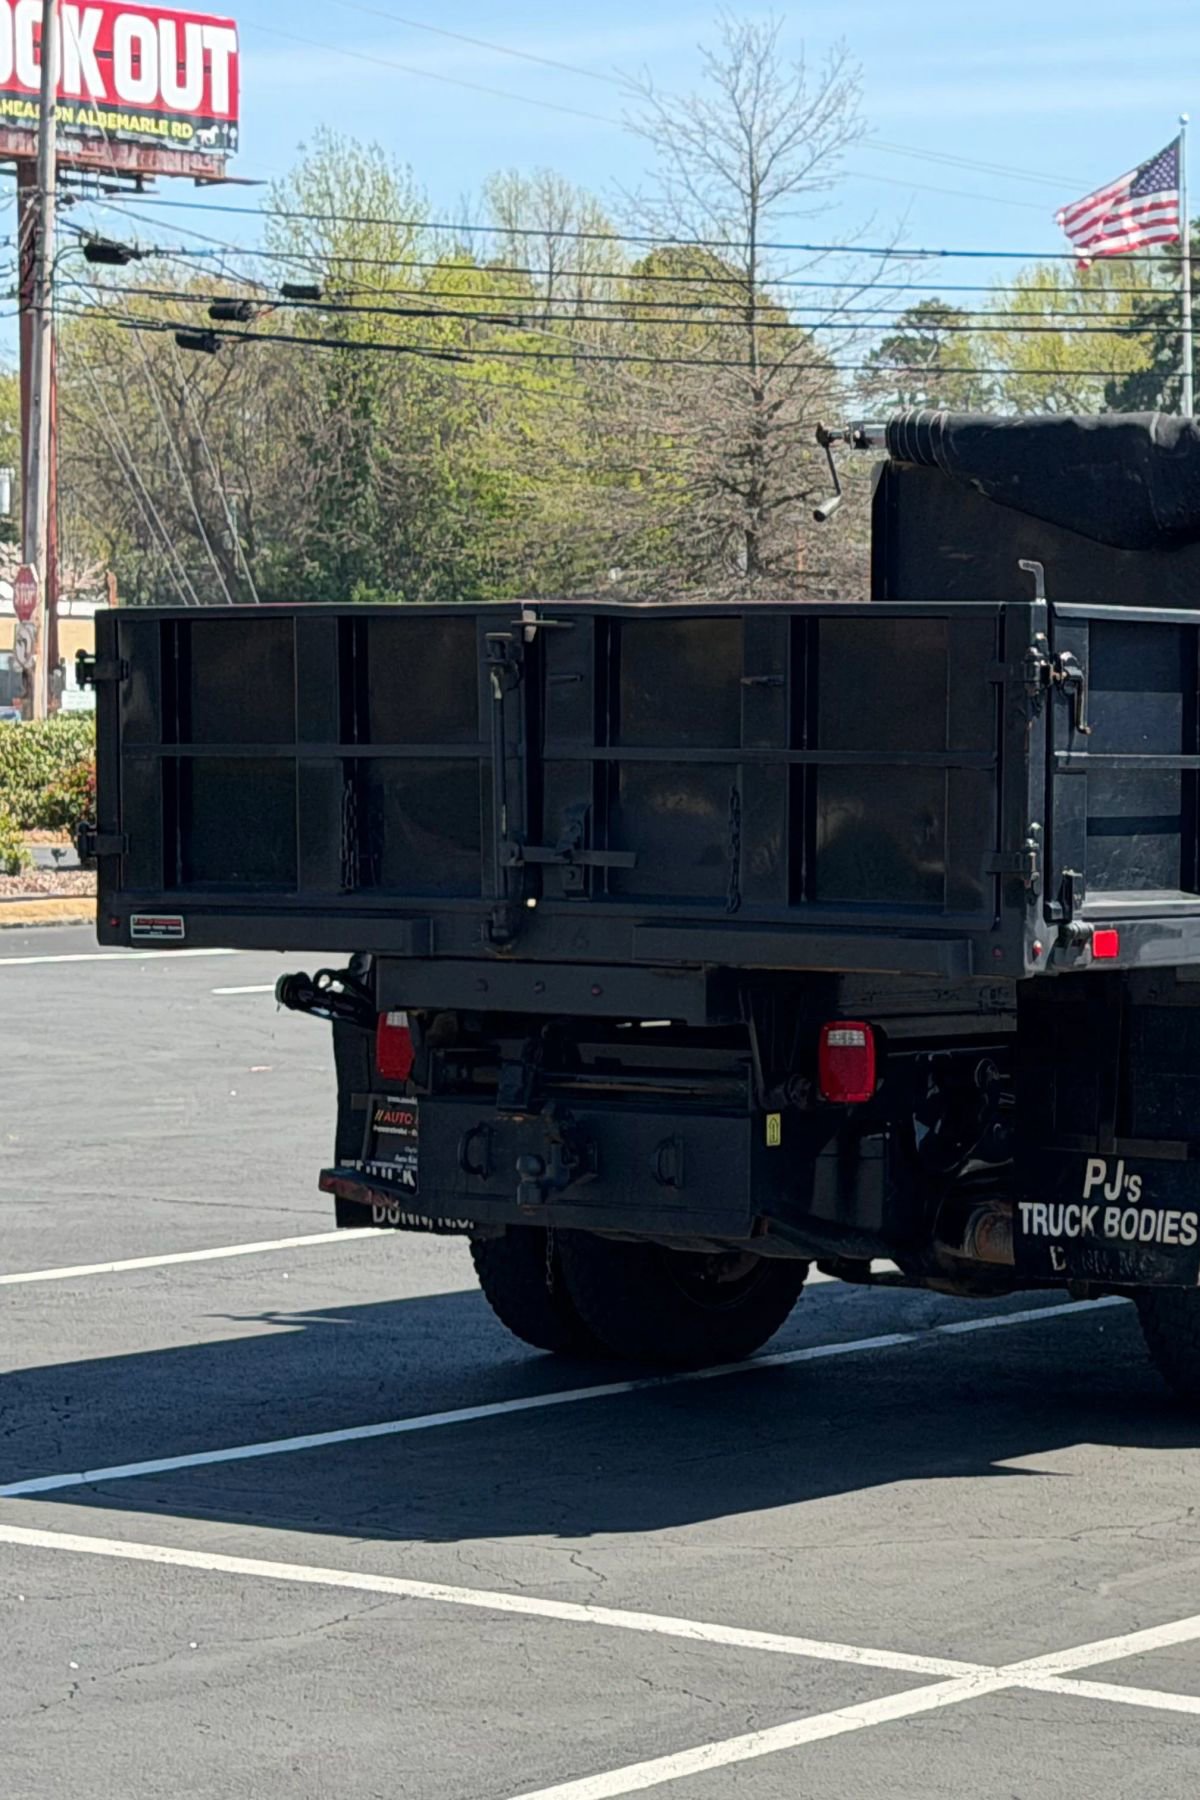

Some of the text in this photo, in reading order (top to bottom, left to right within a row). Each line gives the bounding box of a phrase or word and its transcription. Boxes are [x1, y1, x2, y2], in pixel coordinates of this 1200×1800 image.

[0, 0, 237, 113] OK OUT
[76, 107, 168, 138] ALBEMARLE
[171, 120, 193, 139] RD
[15, 582, 36, 606] STOP
[1083, 1158, 1142, 1203] PJ's
[1018, 1201, 1199, 1246] TRUCK BODIES
